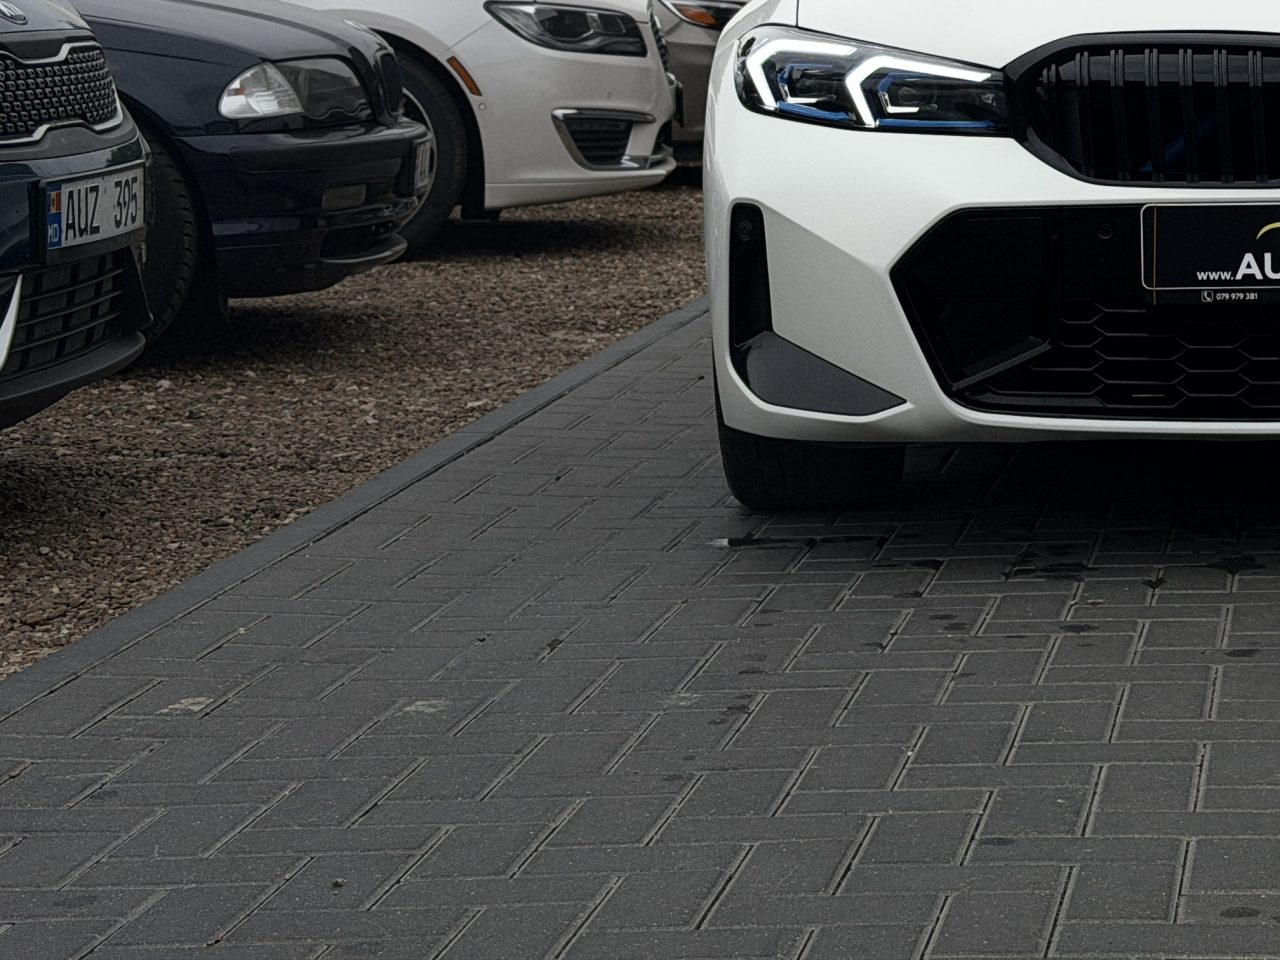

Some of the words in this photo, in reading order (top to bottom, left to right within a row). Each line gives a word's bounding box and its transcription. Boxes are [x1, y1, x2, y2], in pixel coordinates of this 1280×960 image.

[65, 185, 100, 240] AUZ
[114, 176, 138, 229] 395
[1216, 292, 1230, 302] 079
[1231, 292, 1244, 301] 979
[1245, 292, 1258, 301] 381
